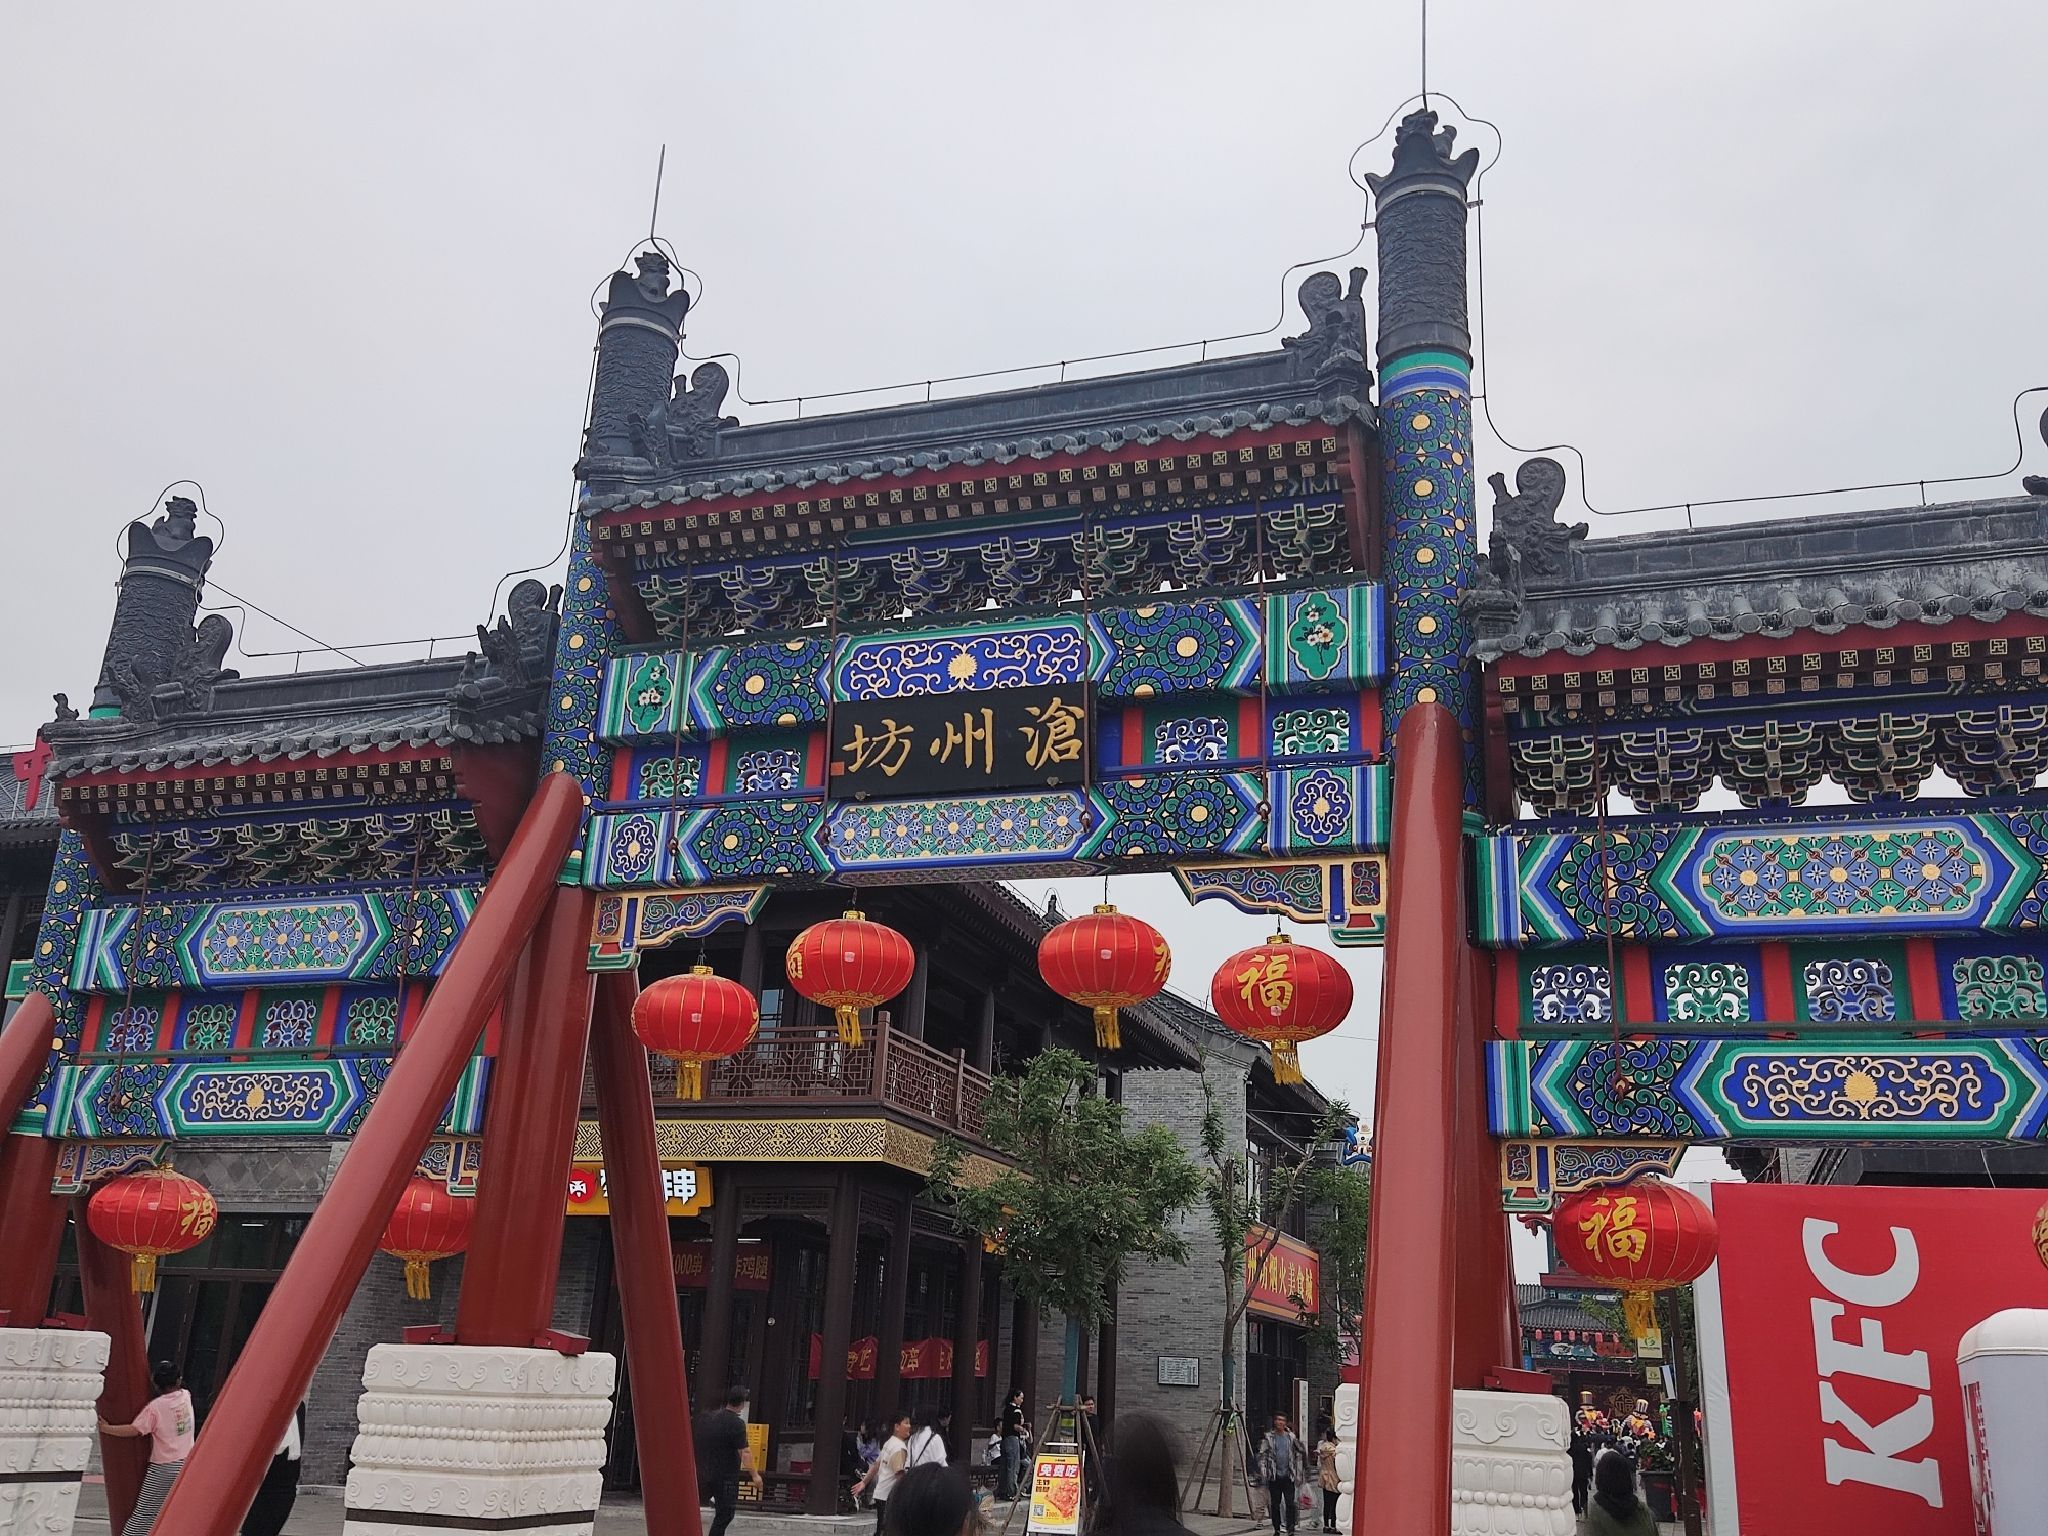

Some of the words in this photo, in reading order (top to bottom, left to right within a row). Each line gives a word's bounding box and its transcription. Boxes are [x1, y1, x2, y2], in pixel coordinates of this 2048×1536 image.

[1237, 954, 1293, 1011] 福
[1579, 1197, 1647, 1262] 福
[1802, 1217, 1943, 1508] KFC
